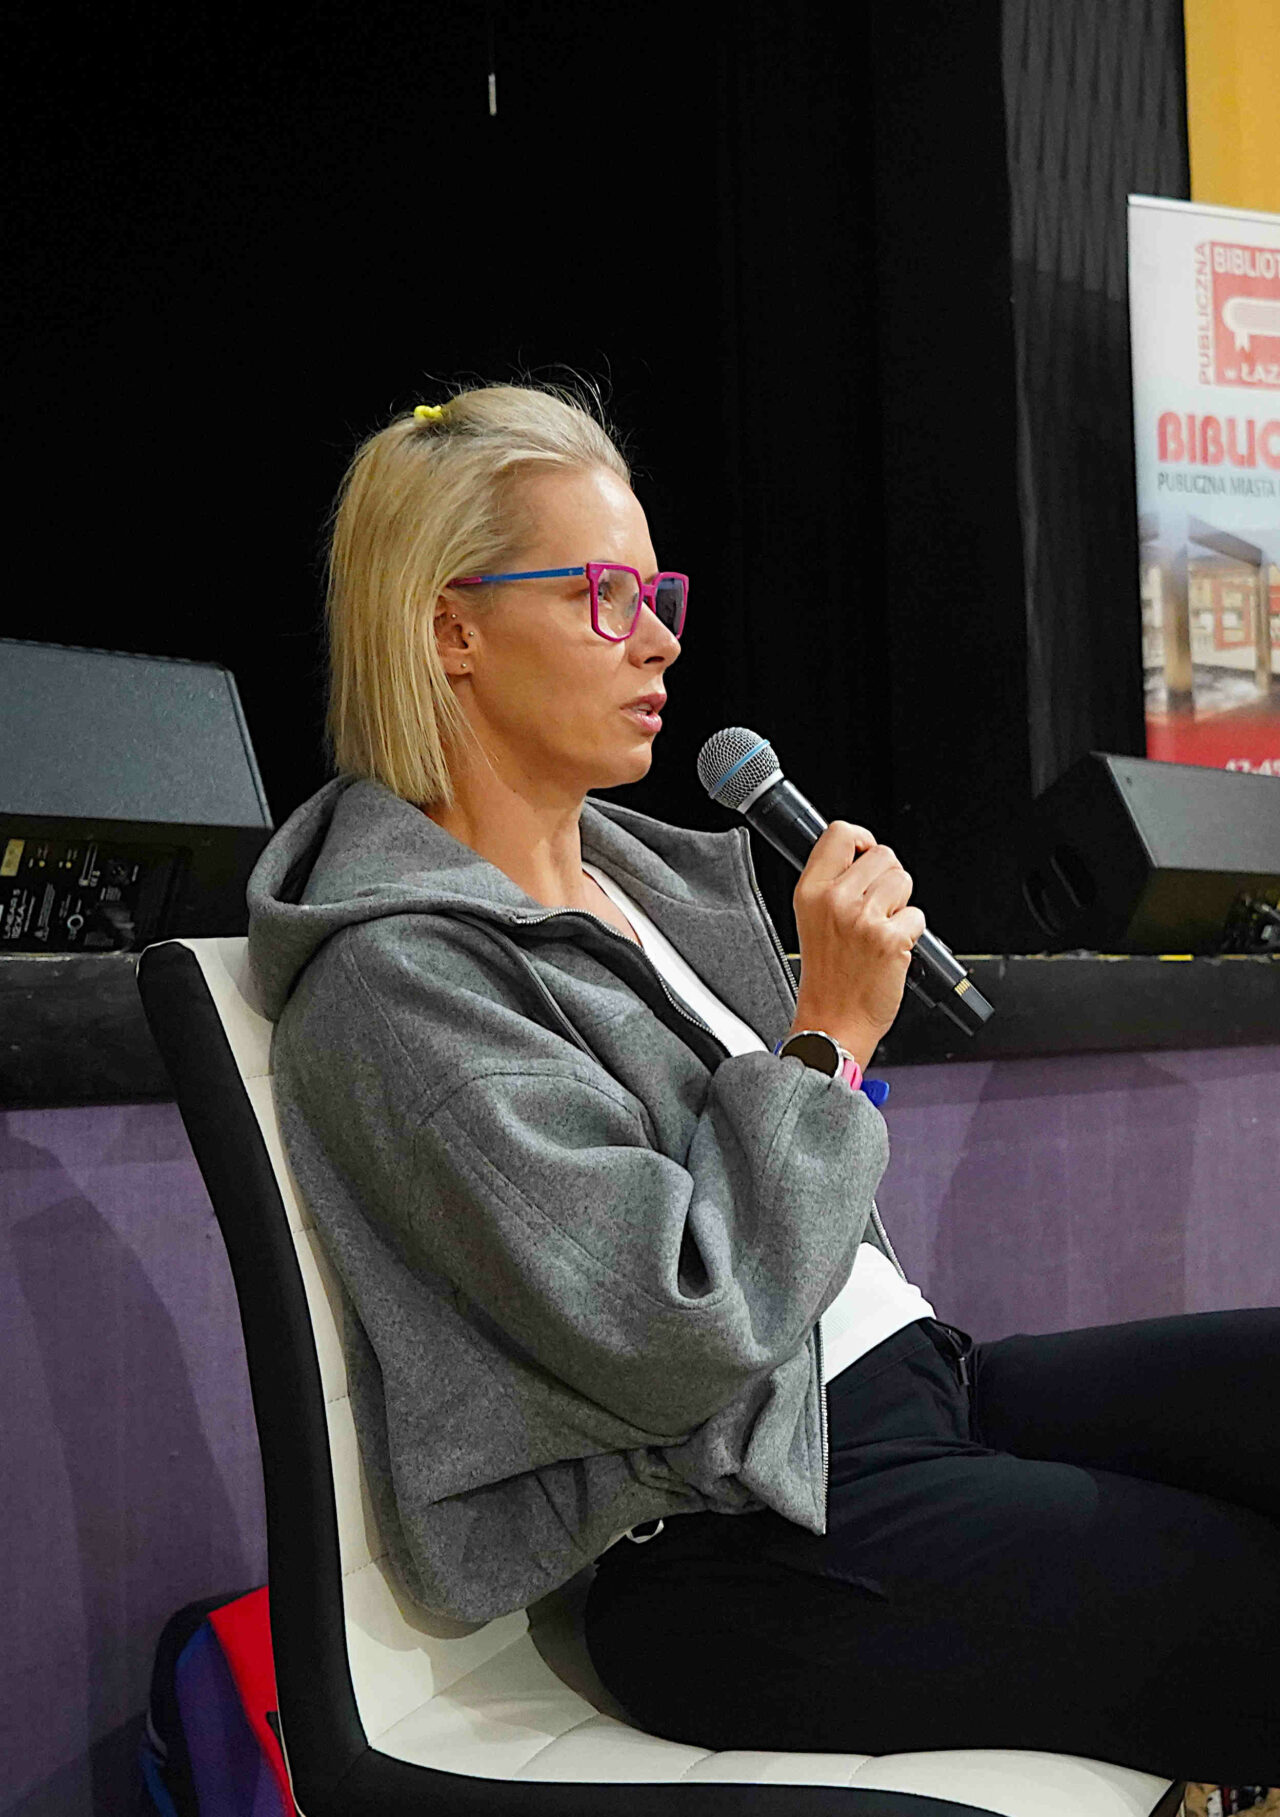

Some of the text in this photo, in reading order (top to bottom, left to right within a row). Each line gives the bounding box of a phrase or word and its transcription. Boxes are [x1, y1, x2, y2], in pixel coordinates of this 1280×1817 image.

[1195, 243, 1211, 385] PUBLICZNA
[1157, 472, 1226, 496] PUBLICZNA
[1230, 475, 1276, 498] MIASTA
